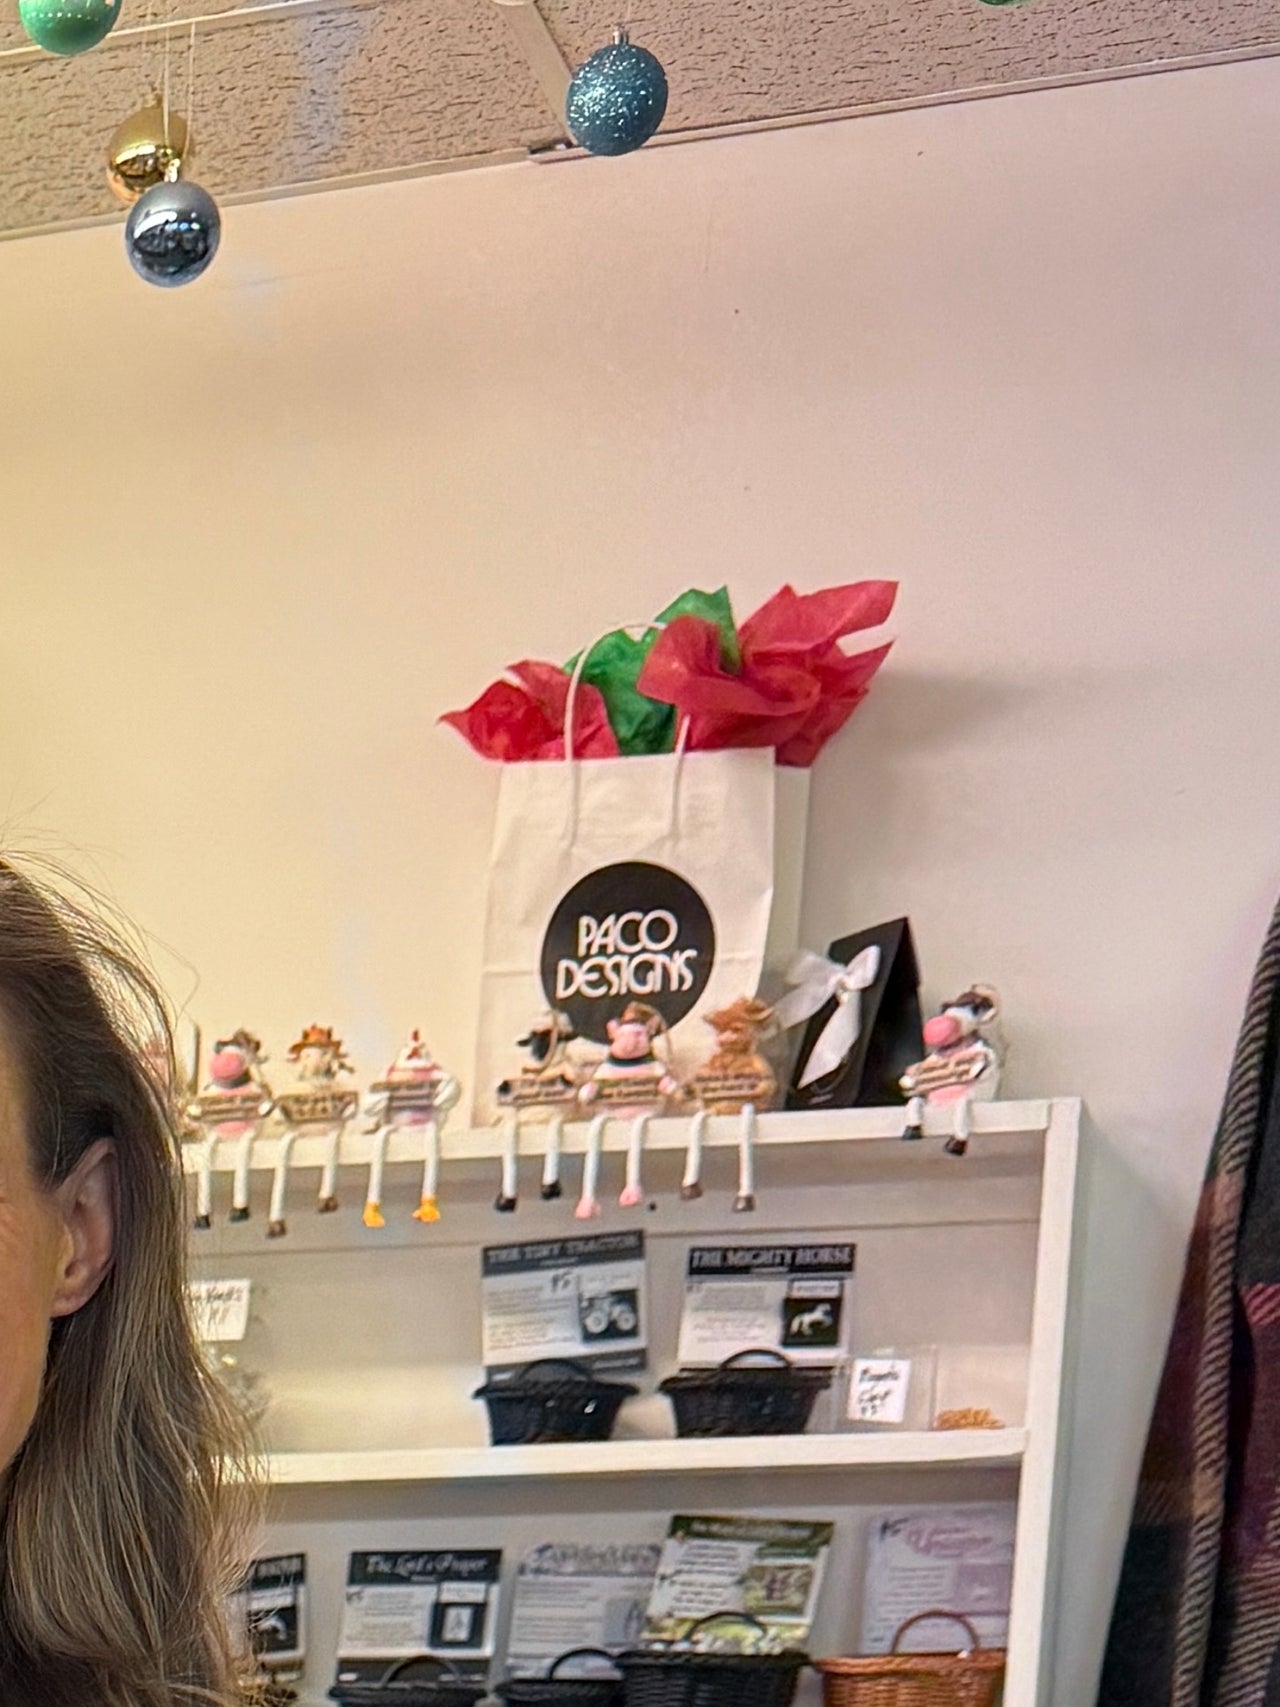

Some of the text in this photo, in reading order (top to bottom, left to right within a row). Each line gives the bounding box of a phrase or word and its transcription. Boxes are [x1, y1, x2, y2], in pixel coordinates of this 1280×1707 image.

[577, 908, 679, 958] PACO
[555, 948, 698, 1000] DESIGNS
[691, 1250, 722, 1268] THE
[365, 1554, 392, 1575] The
